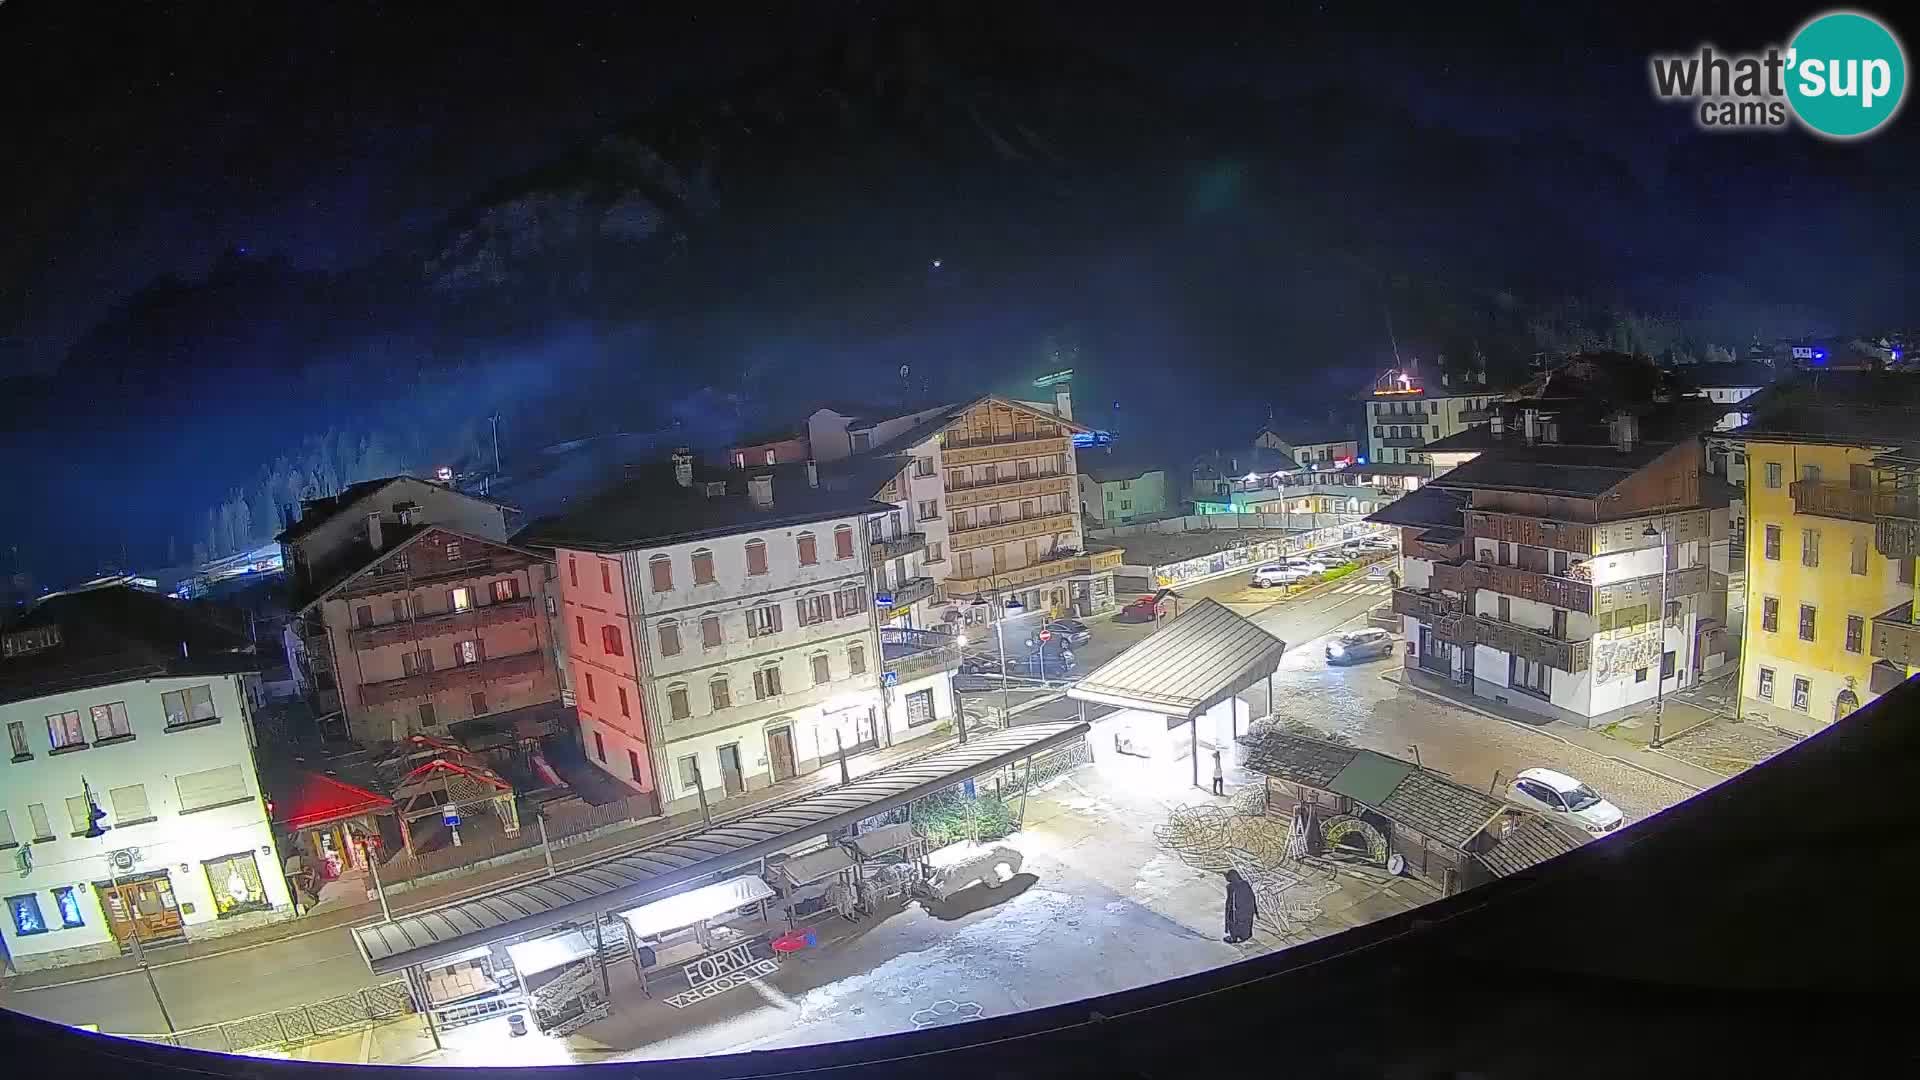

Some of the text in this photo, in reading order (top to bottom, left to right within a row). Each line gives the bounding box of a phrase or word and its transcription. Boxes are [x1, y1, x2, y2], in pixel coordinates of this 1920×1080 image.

[663, 959, 780, 1008] DI SOPRA
[683, 940, 762, 988] FORNI
